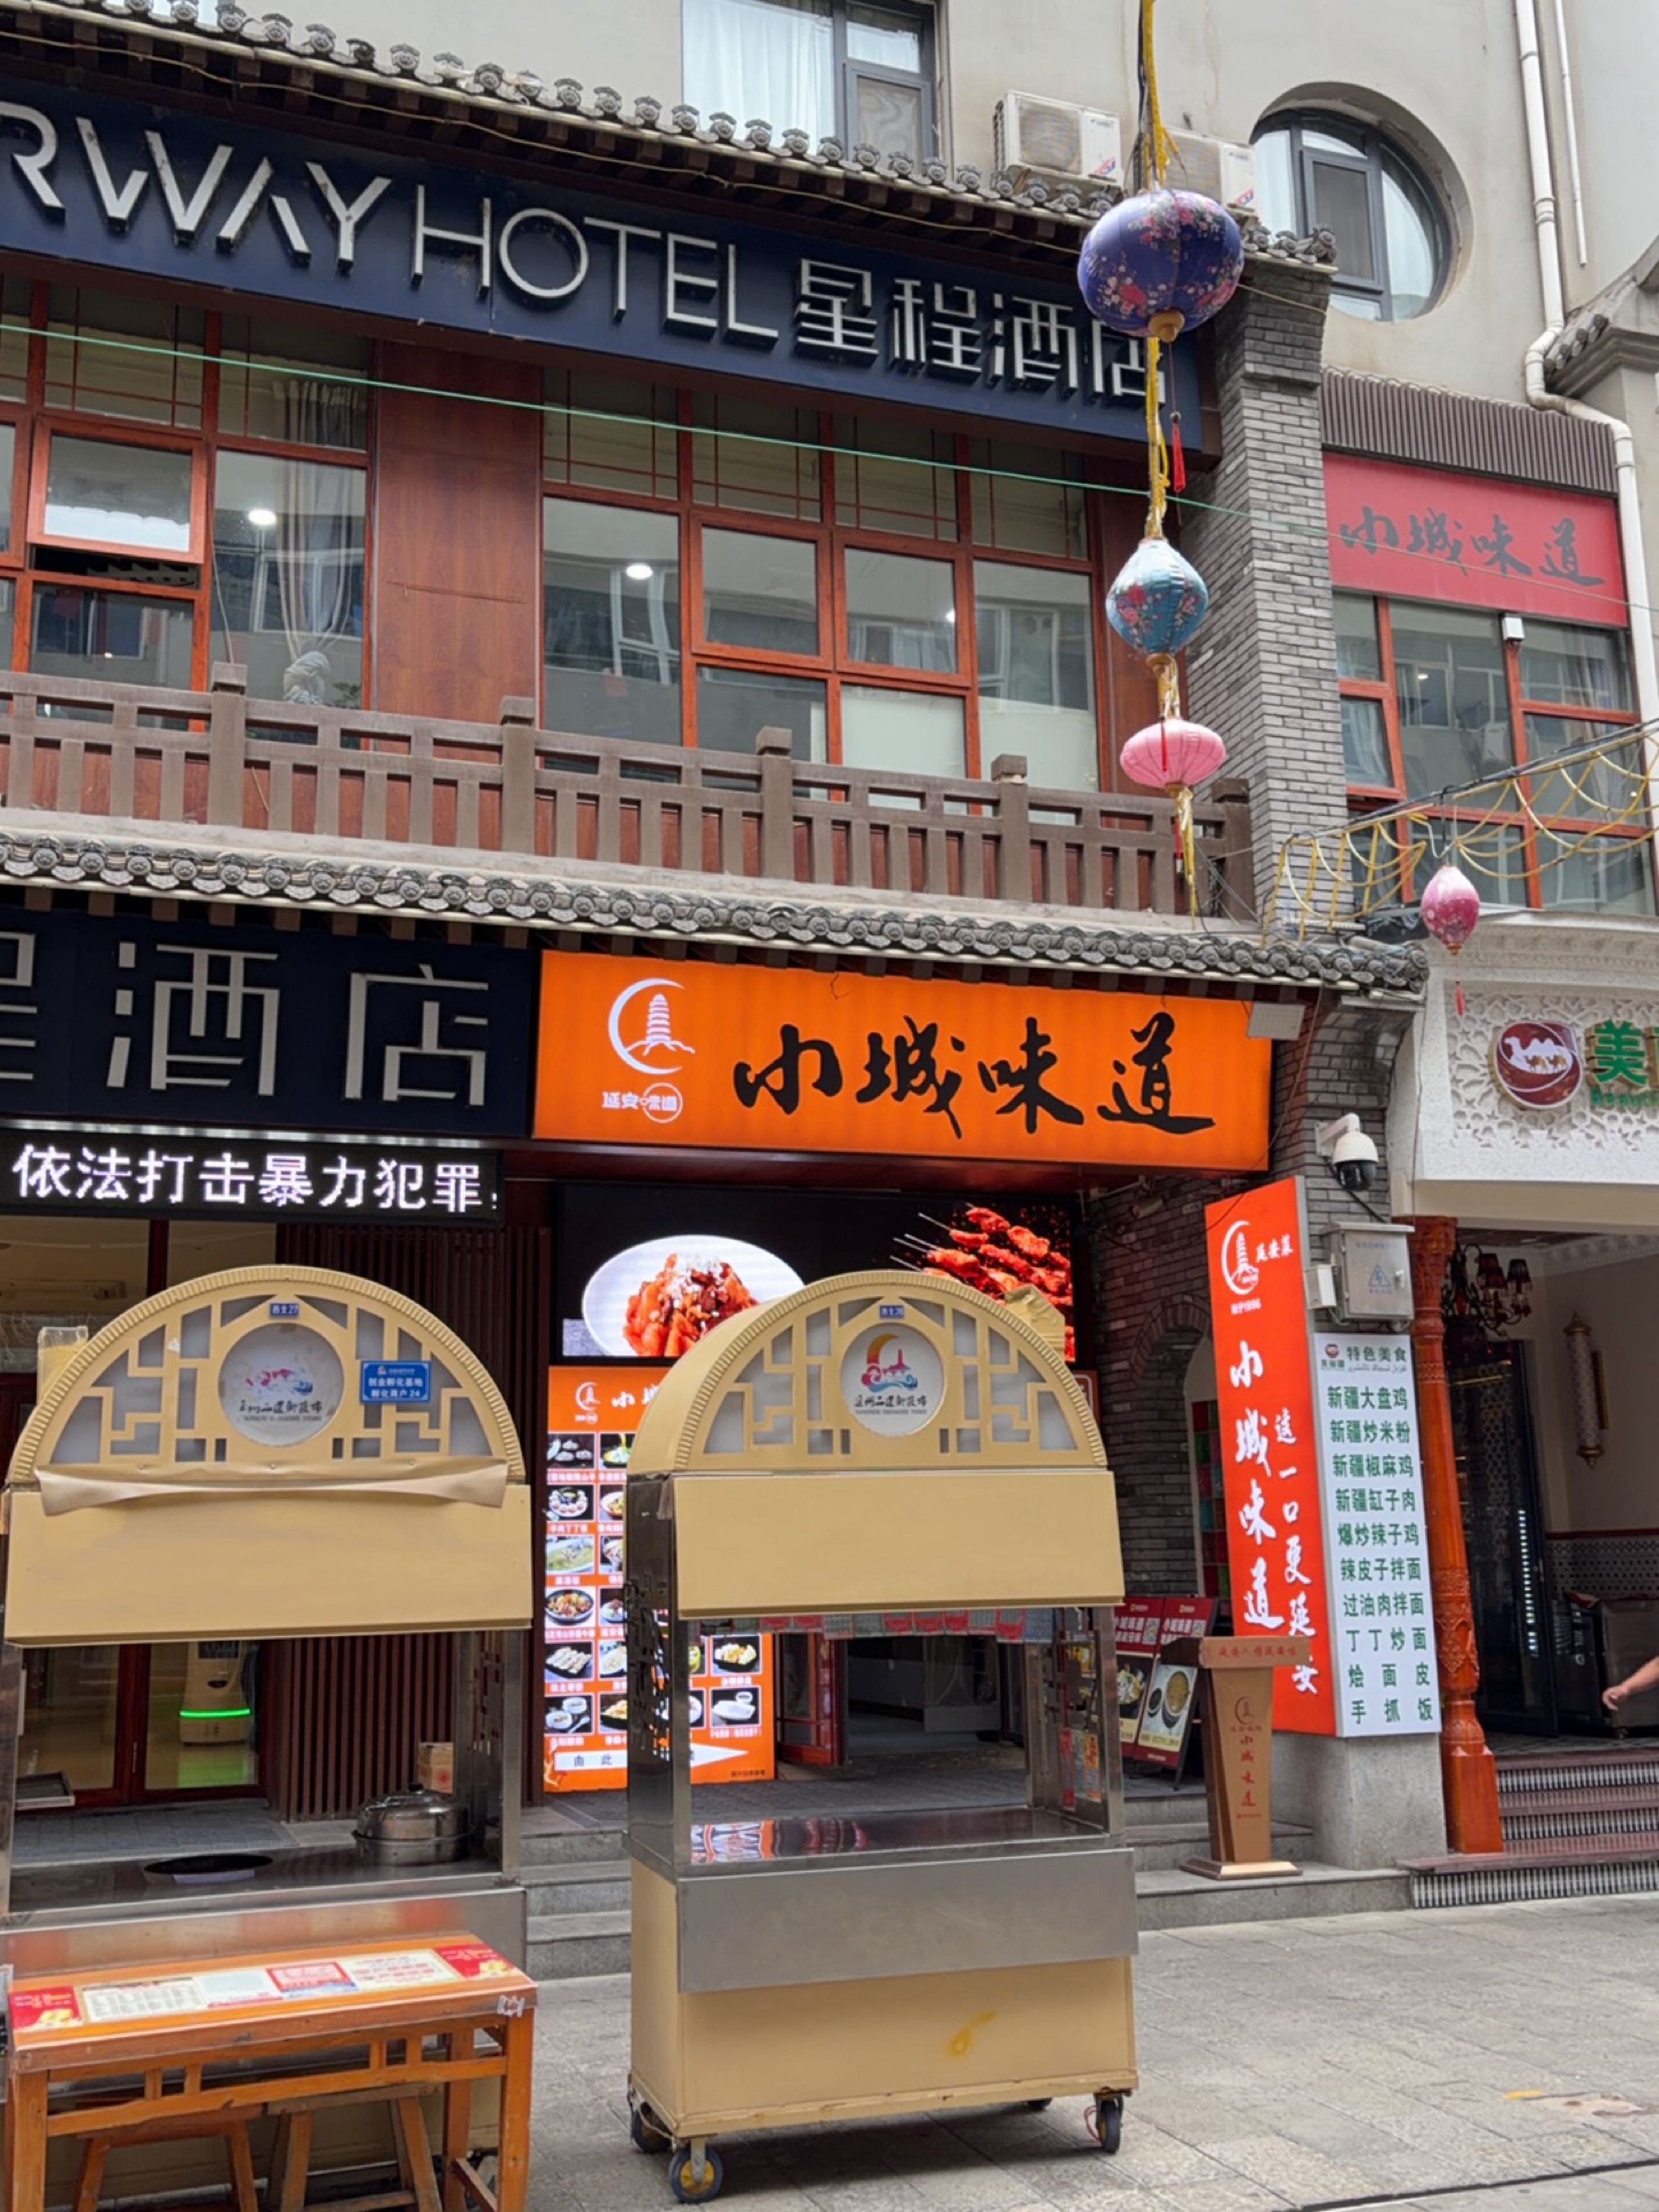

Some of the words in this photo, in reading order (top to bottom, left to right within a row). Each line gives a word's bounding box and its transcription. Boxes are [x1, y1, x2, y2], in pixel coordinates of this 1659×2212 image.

[410, 184, 779, 348] HOTEL
[795, 259, 1166, 406] 星程酒店
[1340, 506, 1605, 587] 小城味道
[0, 931, 489, 1107] 酒店
[1594, 1019, 1659, 1085] 美
[733, 1011, 1216, 1138] 小城味道
[12, 1144, 483, 1214] 依法打击暴力犯罪
[1346, 1346, 1406, 1362] 特色美食
[1327, 1385, 1408, 1410] 新疆大盘鸡
[1329, 1419, 1411, 1444] 新疆炒米粉
[1333, 1454, 1415, 1479] 新疆椒麻鸡
[1230, 1340, 1285, 1629] 小城味道
[1335, 1487, 1416, 1513] 新疆缸子肉
[1337, 1523, 1420, 1546] 爆炒辣子鸡
[1340, 1557, 1422, 1582] 辣皮子拌面
[1343, 1592, 1424, 1618] 过油肉拌面
[1346, 1626, 1427, 1653] 丁丁炒面
[1348, 1661, 1431, 1688] 烩面皮
[1350, 1698, 1434, 1726] 手抓饭
